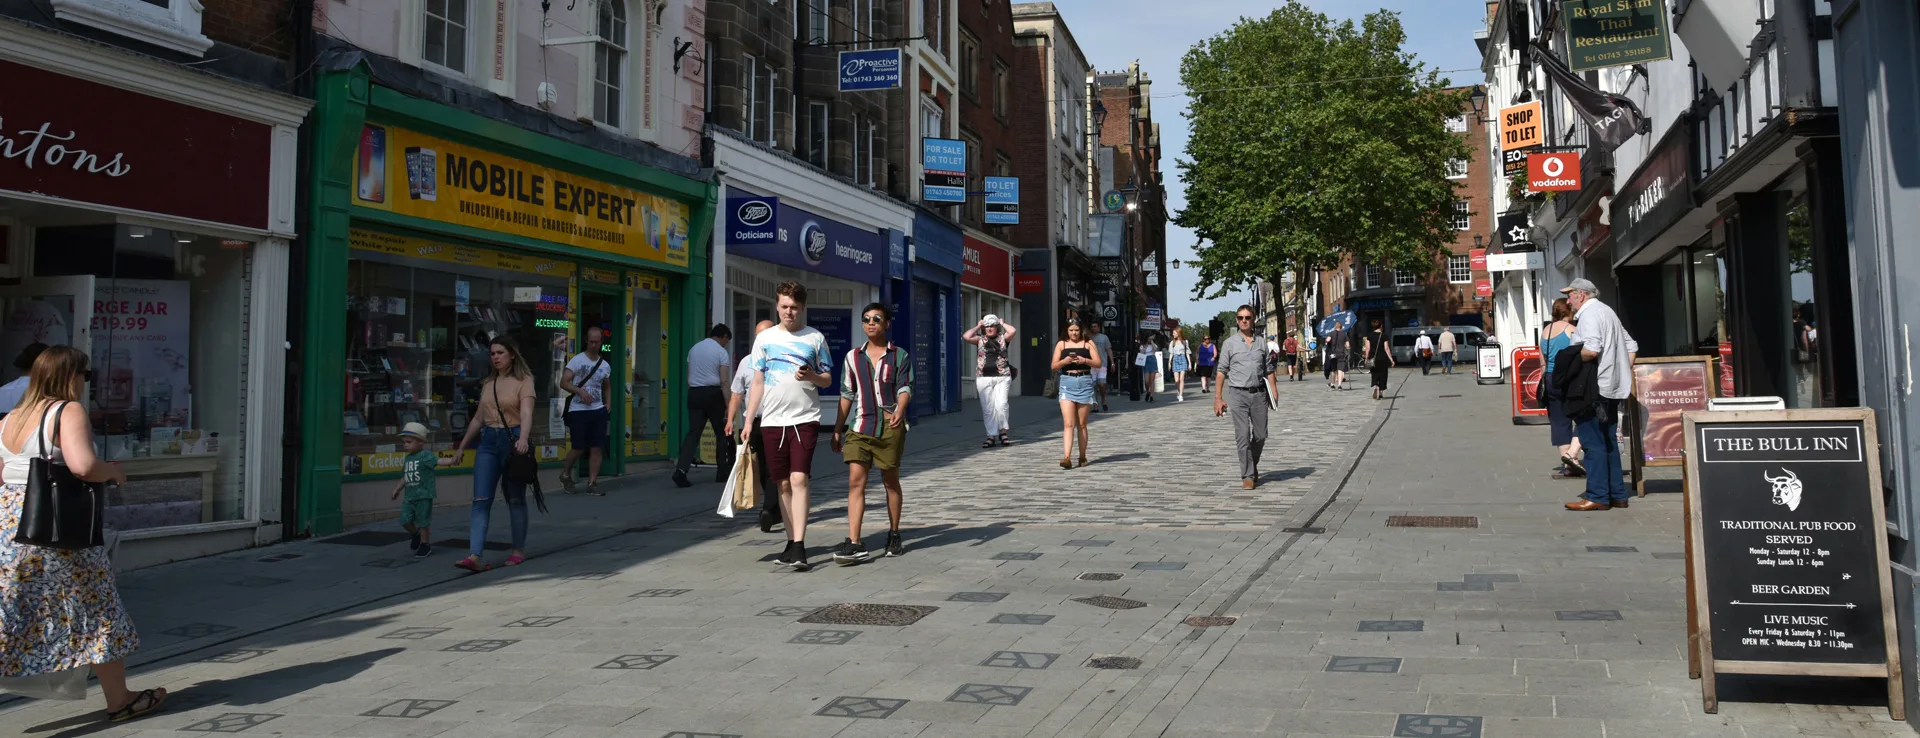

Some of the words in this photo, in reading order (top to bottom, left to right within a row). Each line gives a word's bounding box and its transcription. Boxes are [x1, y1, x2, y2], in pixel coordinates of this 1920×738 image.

[1574, 2, 1613, 18] Royal
[1616, 0, 1652, 11] Siam
[1597, 16, 1633, 31] Thai
[1575, 26, 1660, 48] Restaurant
[1598, 52, 1621, 60] 01743
[1624, 47, 1652, 57] 351188
[859, 58, 898, 67] Proactive
[1506, 109, 1533, 126] SHOP
[1506, 131, 1518, 144] TO
[1520, 126, 1536, 140] LET
[0, 118, 130, 176] ntons
[942, 146, 961, 154] SALE
[1532, 178, 1576, 188] vodafone
[446, 152, 544, 206] MOBILE
[554, 180, 635, 226] EXPERT
[742, 206, 768, 220] Boots
[460, 200, 505, 222] UNLOCKING
[513, 211, 539, 228] REPAIR
[583, 225, 625, 245] ACCESSORIES
[371, 234, 406, 244] Repair
[735, 231, 774, 240] Opticians
[349, 238, 382, 249] While
[417, 244, 443, 255] WAIT
[835, 240, 872, 264] hearingcare
[962, 246, 980, 265] AMUEL
[534, 262, 557, 272] WAIT
[135, 300, 168, 315] JAR
[1360, 299, 1393, 308] BARCLAYS
[92, 315, 147, 330] £19.99
[536, 319, 569, 328] ACCESSORIE
[1714, 437, 1754, 451] THE
[1757, 437, 1809, 451] BULL
[1813, 436, 1848, 450] INN
[368, 452, 405, 469] Cracked
[1720, 520, 1798, 531] TRADITIONAL
[1799, 521, 1822, 531] PUB
[1824, 522, 1856, 531] FOOD
[1766, 535, 1813, 544] SERVED
[1749, 548, 1770, 556] Monday
[1776, 548, 1800, 557] Saturday
[1817, 548, 1830, 557] 8pm
[1756, 558, 1776, 566] Sunday
[1811, 559, 1824, 568] 6pm
[1752, 584, 1779, 594] BEER
[1781, 585, 1830, 595] GARDEN
[1764, 615, 1789, 625] LIVE
[1791, 616, 1828, 626] MUSIC
[1748, 628, 1763, 637] Every
[1766, 628, 1782, 637] Friday
[1791, 629, 1815, 638] Saturday
[1830, 630, 1845, 638] 11pm
[1776, 639, 1806, 648] Wednesday
